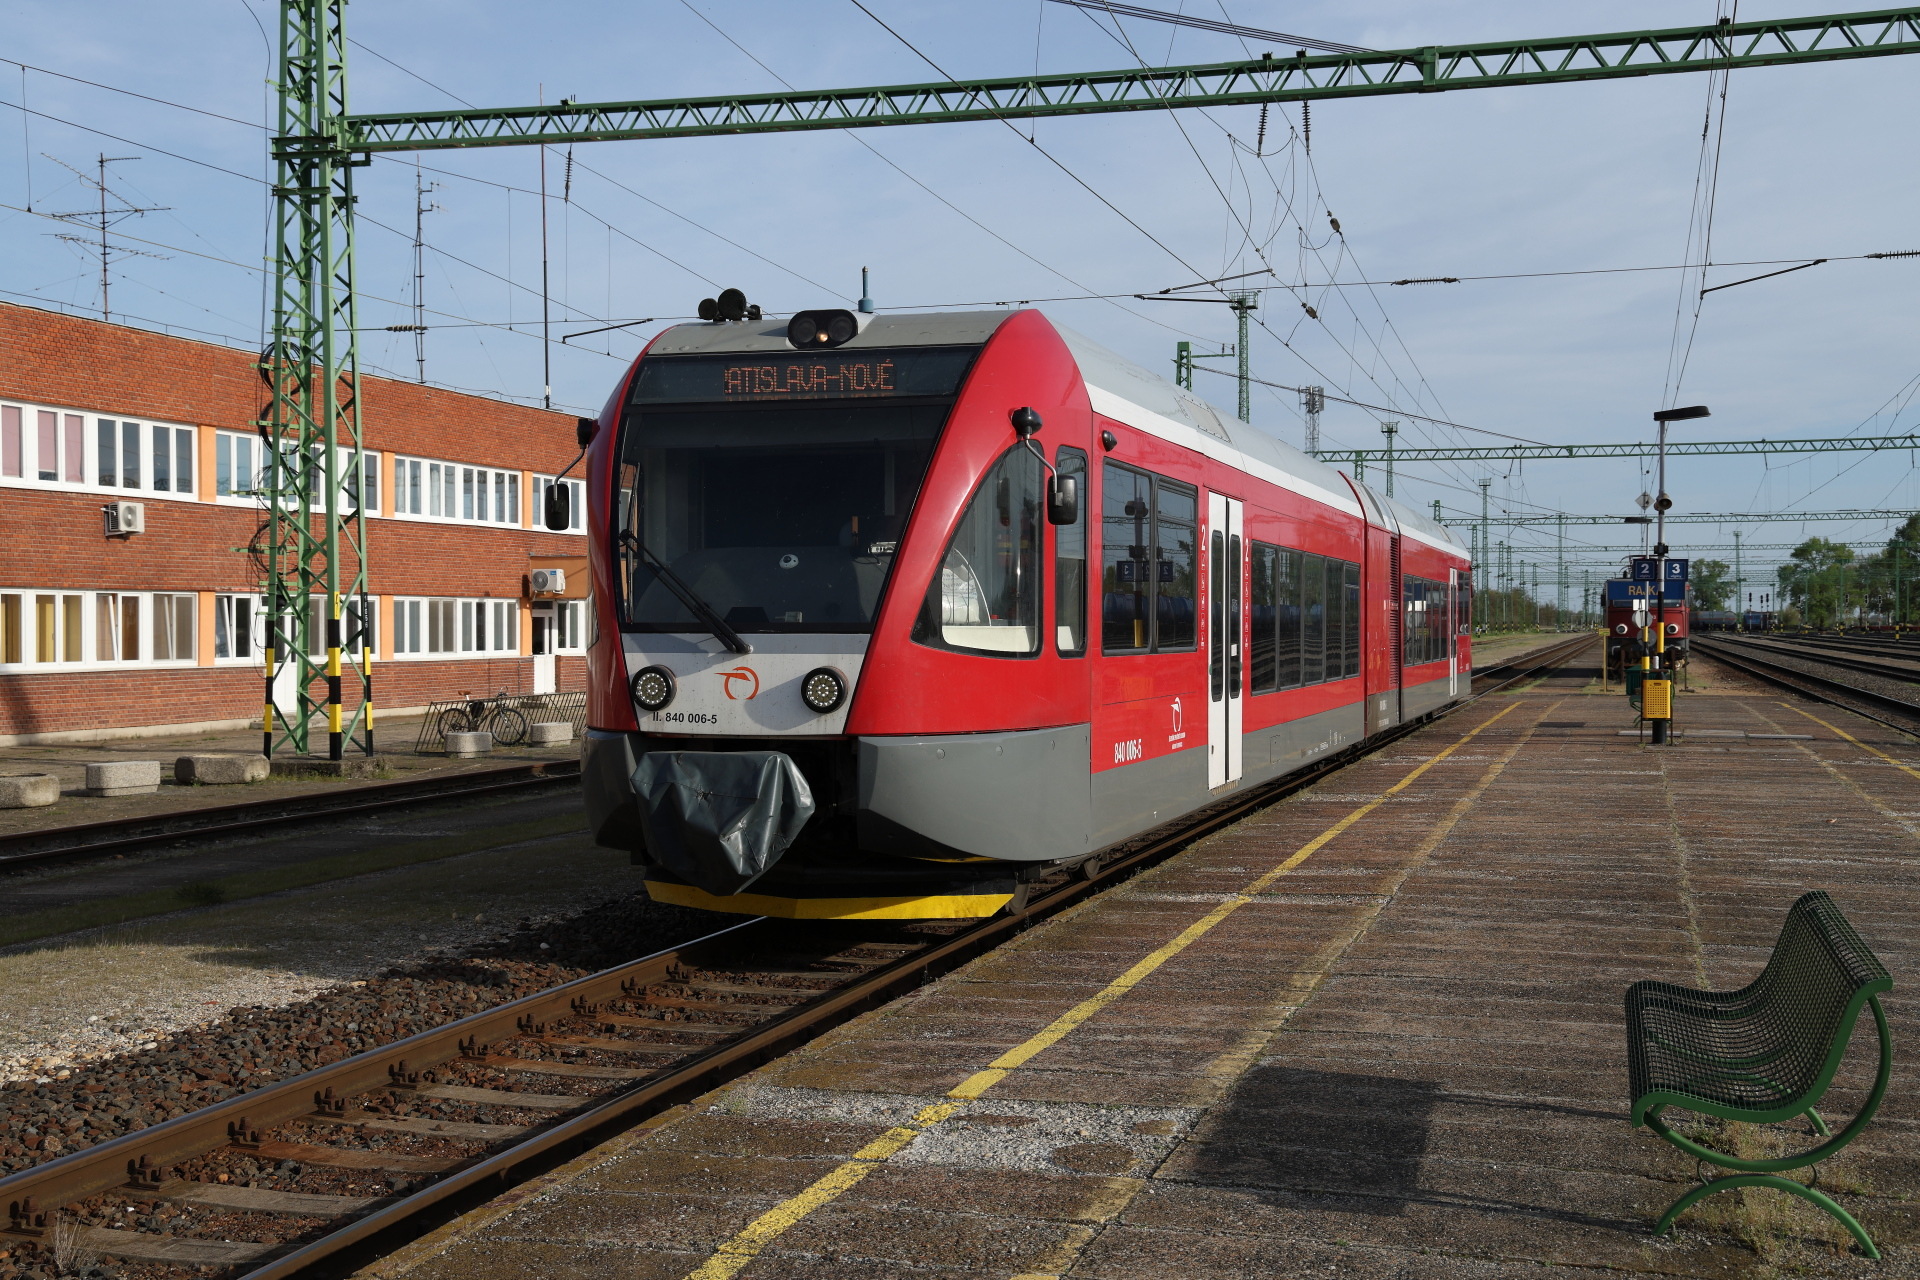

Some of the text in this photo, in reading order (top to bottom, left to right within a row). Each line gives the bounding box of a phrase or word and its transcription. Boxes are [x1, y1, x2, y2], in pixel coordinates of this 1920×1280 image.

[1201, 523, 1206, 551] 2
[1641, 563, 1649, 574] 2
[1671, 563, 1680, 574] 3
[1628, 585, 1659, 595] RAK
[665, 712, 685, 723] 840
[687, 713, 718, 724] 006-5
[1114, 738, 1142, 764] 840 006-5
